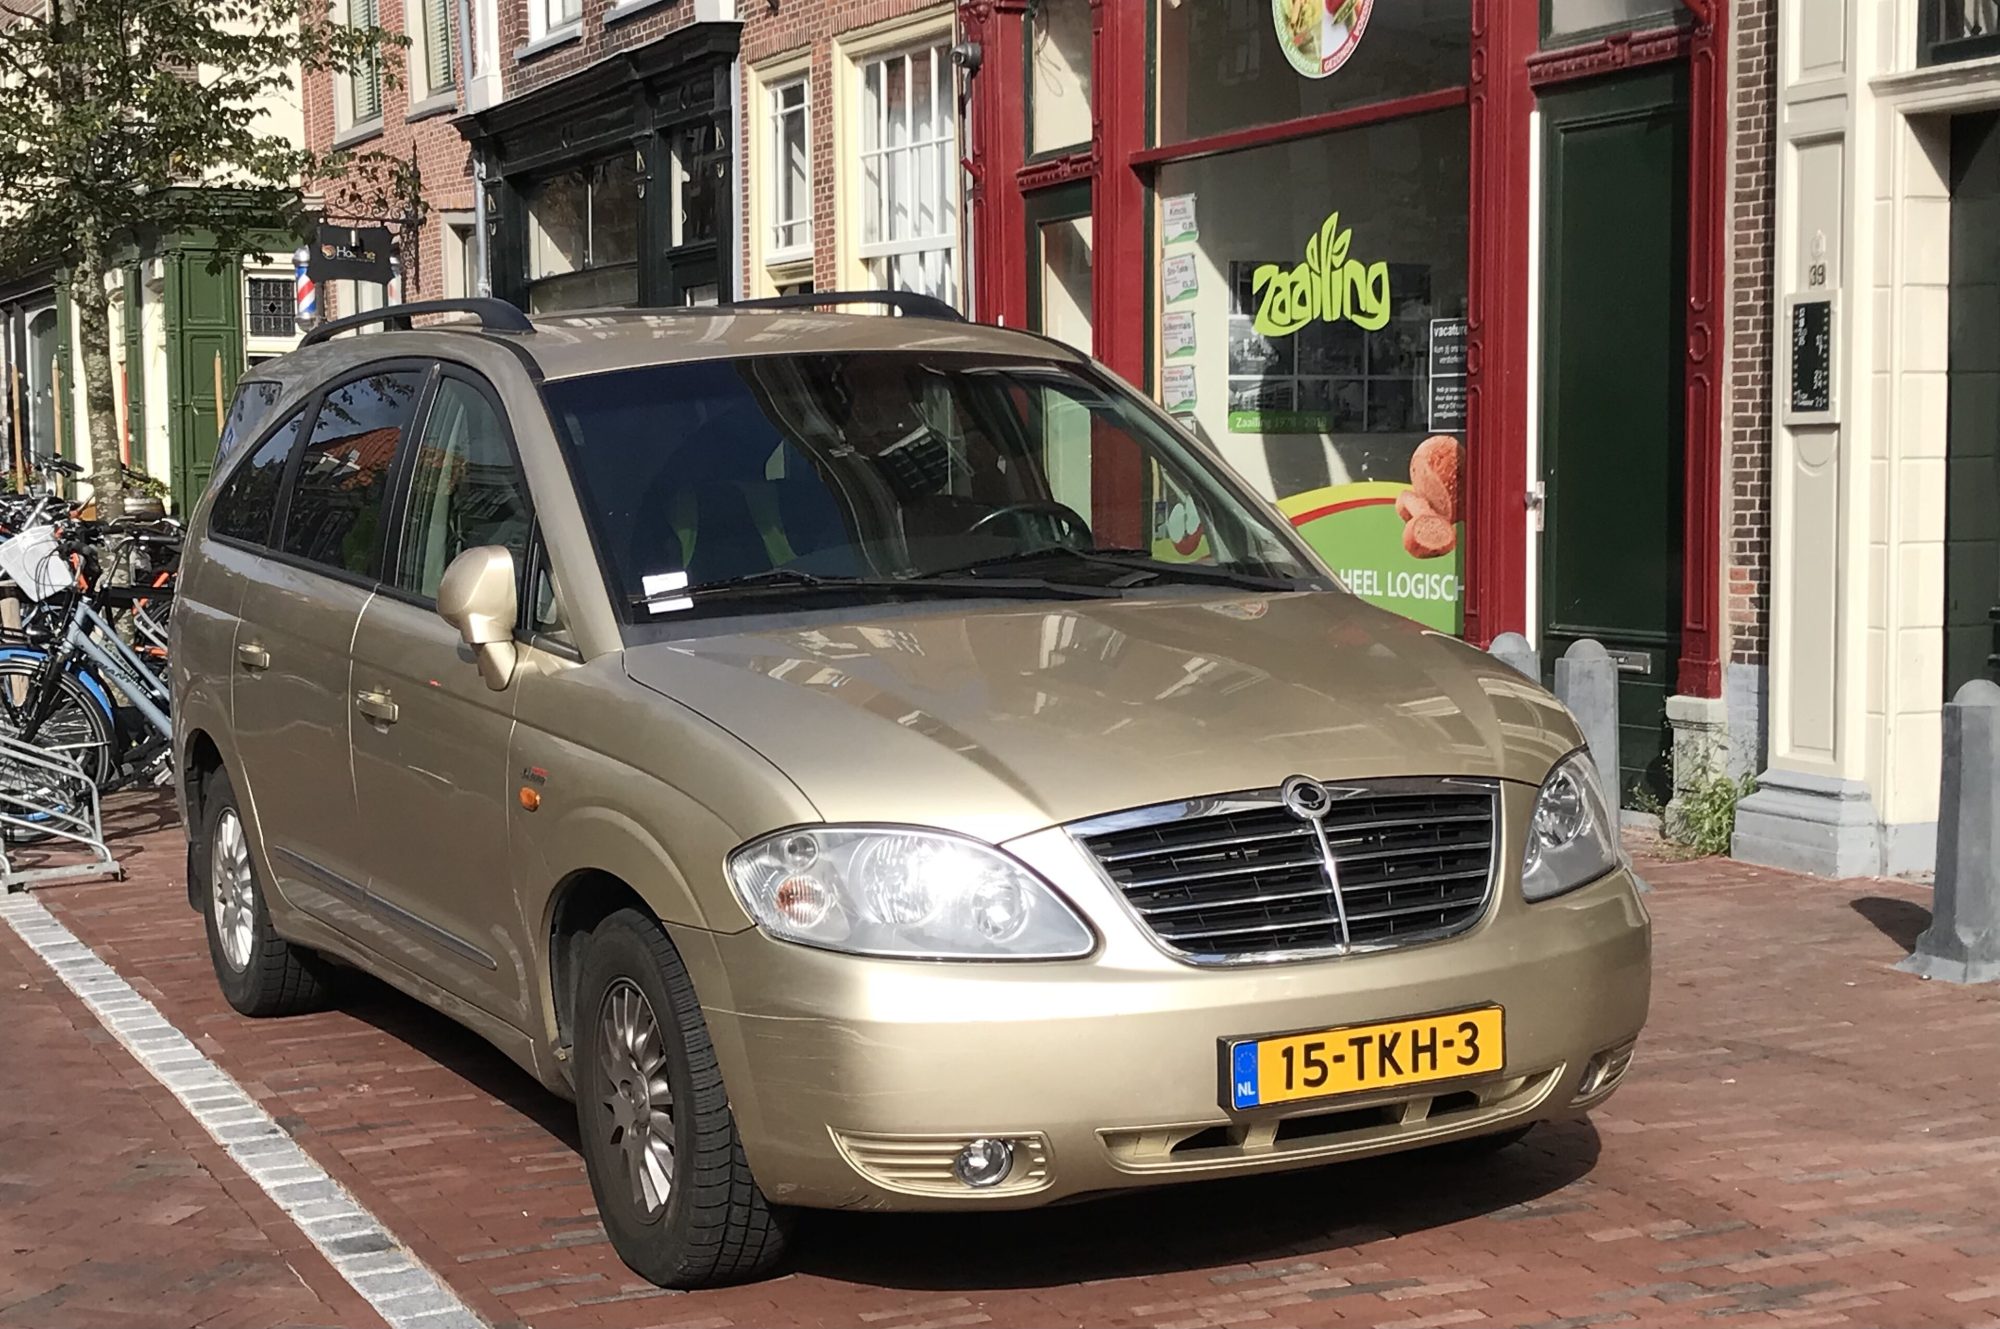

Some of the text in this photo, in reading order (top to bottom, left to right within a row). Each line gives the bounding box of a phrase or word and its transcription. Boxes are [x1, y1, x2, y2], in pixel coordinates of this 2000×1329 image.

[1808, 264, 1827, 286] 39
[1340, 568, 1383, 596] HEEL
[1281, 1020, 1480, 1091] 15-TKH-3
[1237, 1080, 1256, 1098] NL
